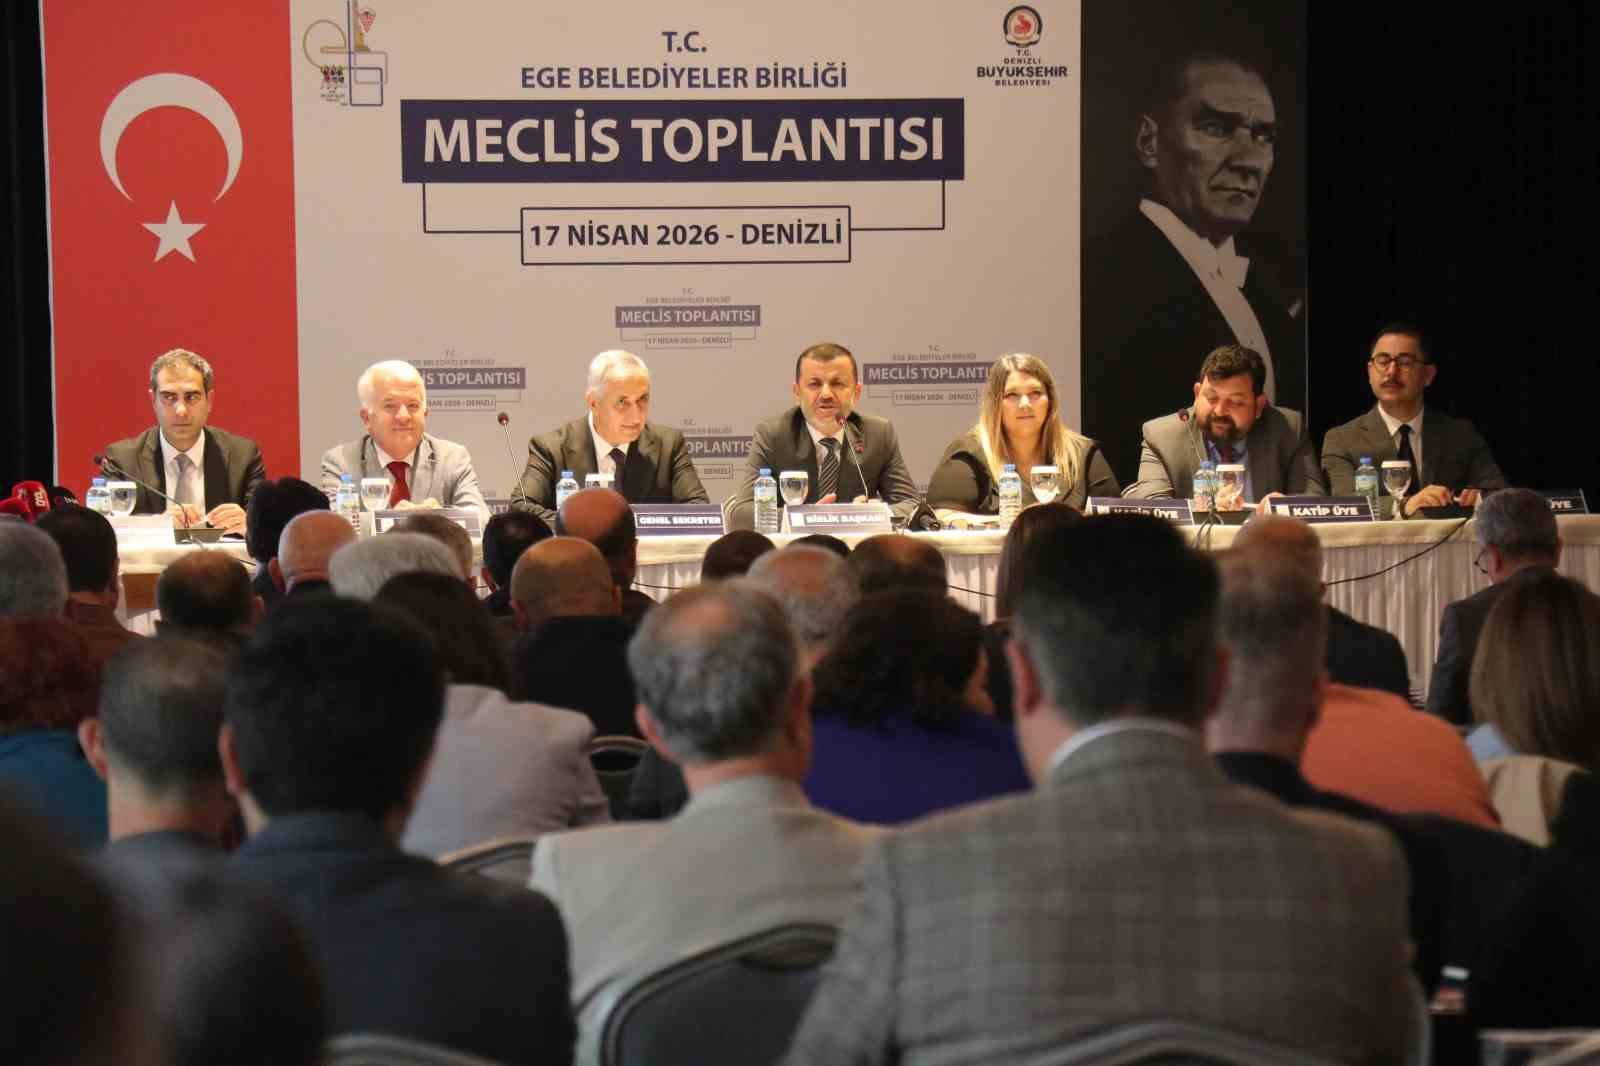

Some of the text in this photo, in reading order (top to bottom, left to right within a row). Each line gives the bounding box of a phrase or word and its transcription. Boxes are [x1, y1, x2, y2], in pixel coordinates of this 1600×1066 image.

[661, 31, 708, 53] T.C.
[521, 61, 848, 89] EGE BELEDİYELER BİRLİĞİ
[423, 107, 944, 163] MECLİS TOPLANTISI
[530, 225, 560, 246] 17
[567, 219, 649, 246] NİSAN
[656, 224, 720, 246] 2026
[741, 218, 842, 246] DENİZLİ
[620, 307, 756, 323] MECLİS TOPLANTISI
[438, 371, 521, 386] TOPLANTISI
[868, 363, 919, 380] MECLİS
[1293, 504, 1359, 516] KATİP ÜYE
